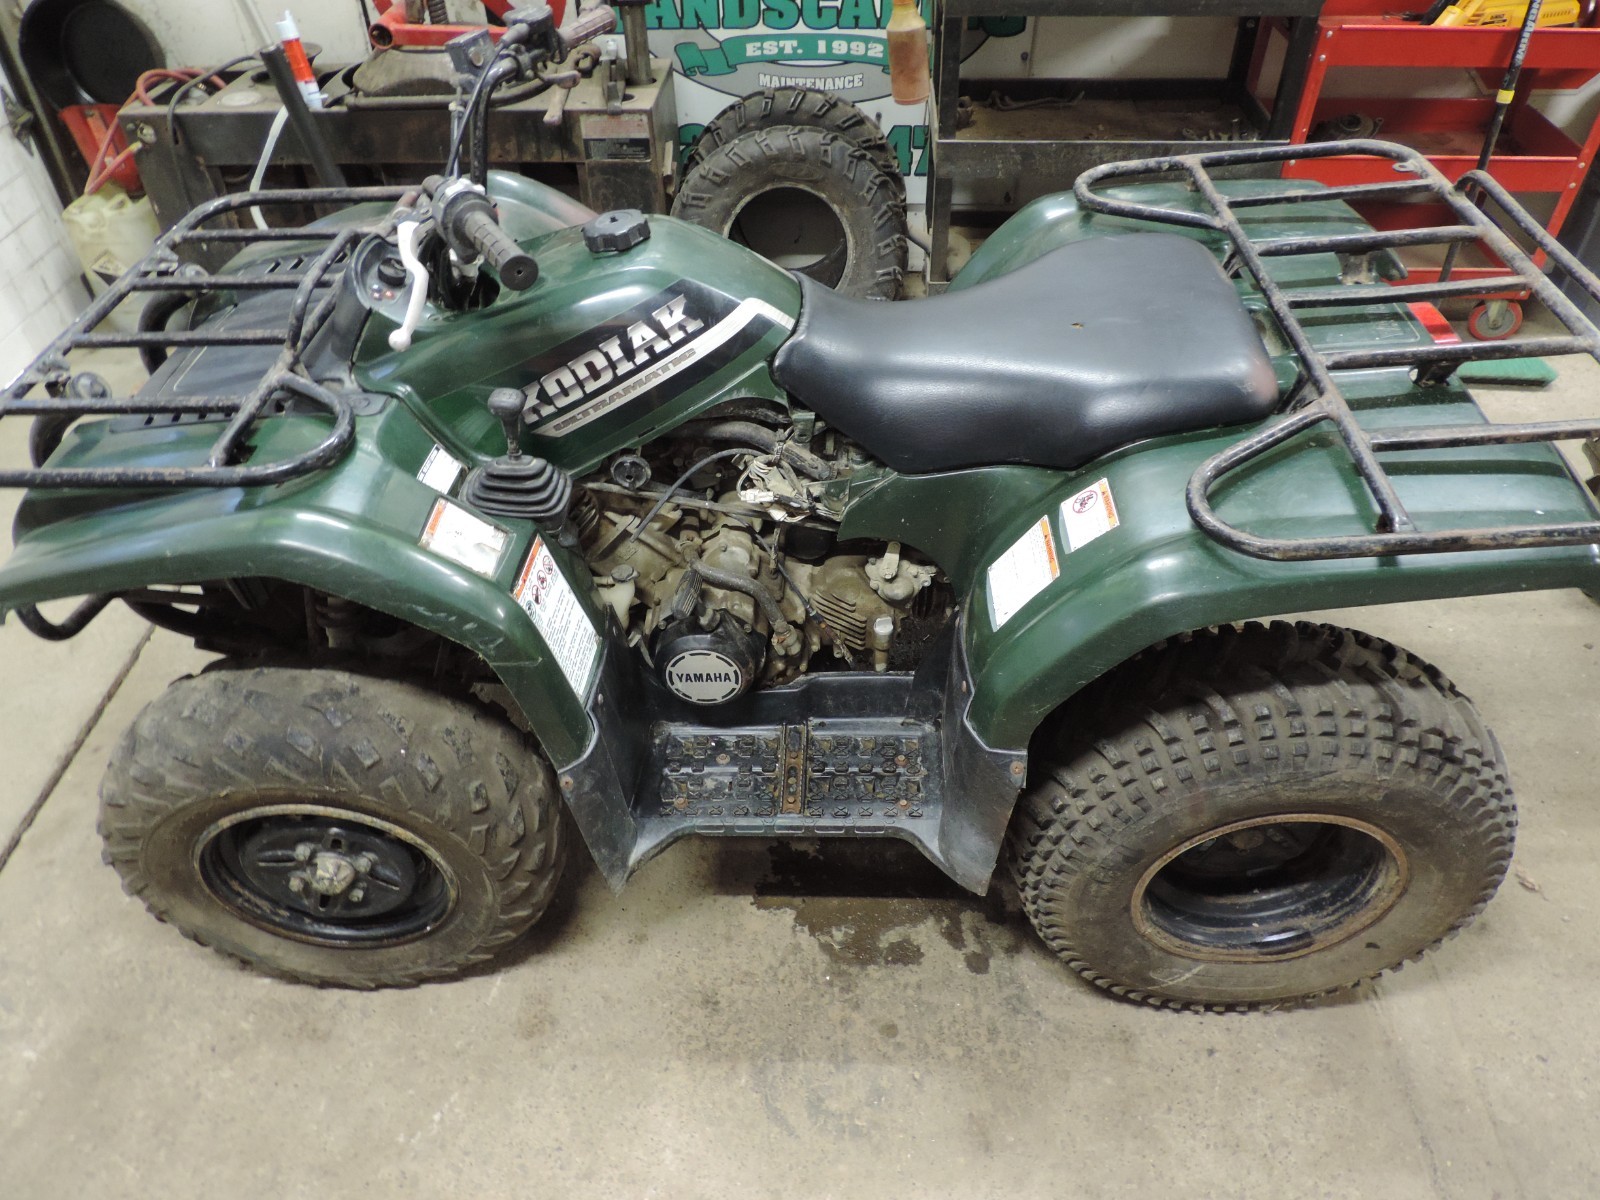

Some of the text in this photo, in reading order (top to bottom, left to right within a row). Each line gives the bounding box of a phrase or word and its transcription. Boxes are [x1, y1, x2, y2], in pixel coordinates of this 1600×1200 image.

[745, 40, 884, 58] EST. 1992
[759, 73, 864, 91] MAINTENANCE
[520, 293, 705, 425] KODIAK
[553, 348, 696, 432] ULTRAMATIC
[676, 672, 732, 683] YAMAHA
